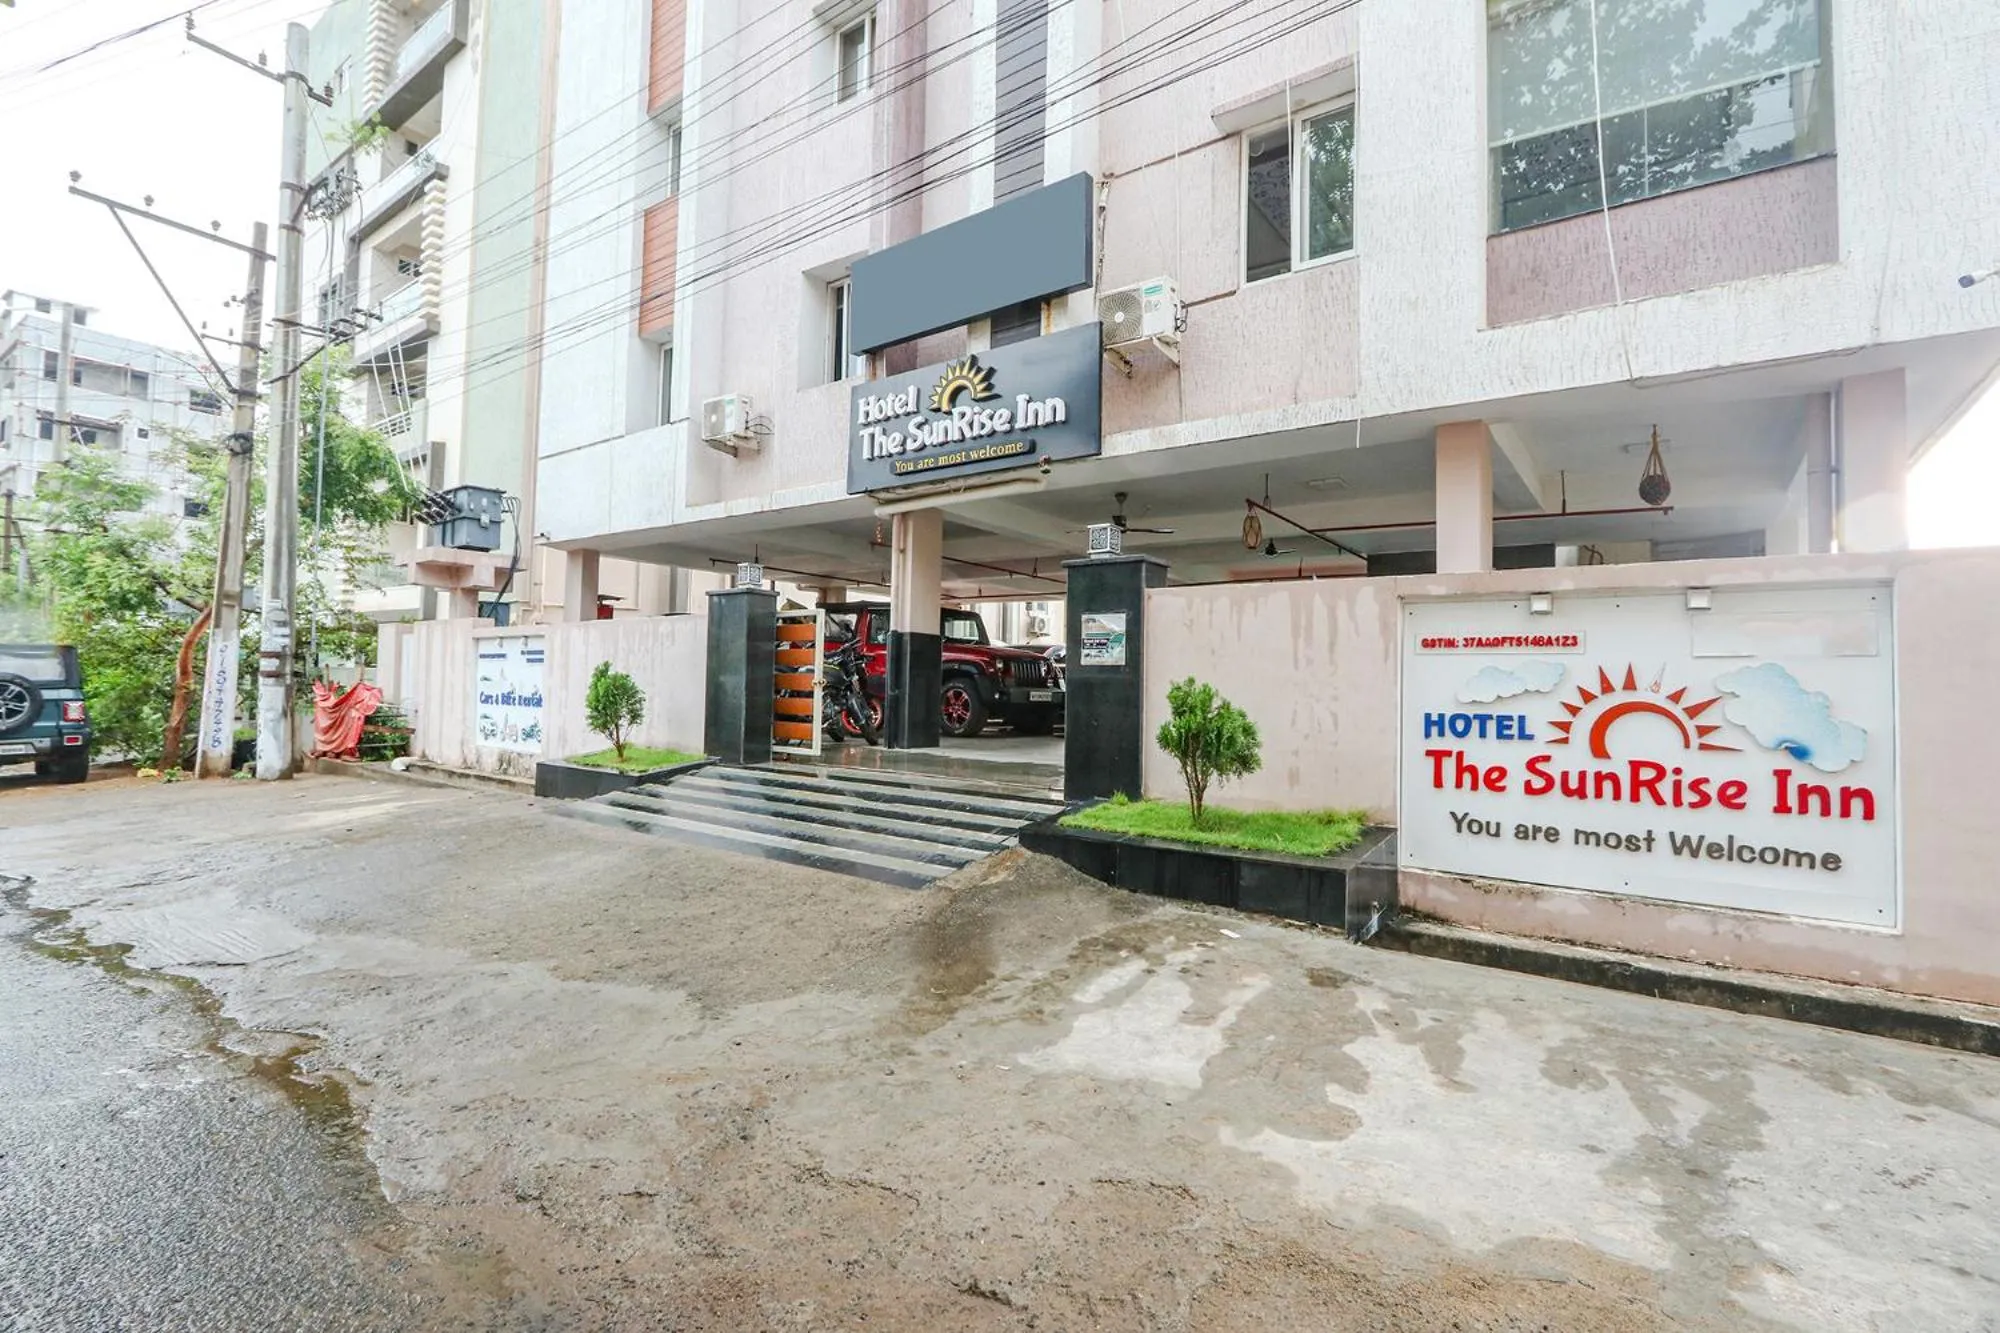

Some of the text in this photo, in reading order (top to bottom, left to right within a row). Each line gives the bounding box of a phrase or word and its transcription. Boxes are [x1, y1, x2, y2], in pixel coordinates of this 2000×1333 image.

[857, 384, 919, 424] Hotel
[859, 394, 1067, 460] The SunRise Inn
[895, 441, 1024, 473] You are most welcome
[1421, 637, 1459, 649] GSTIN:
[1424, 713, 1535, 741] HOTEL
[1425, 749, 1876, 820] The SunRise Inn
[1449, 811, 1843, 872] You are most Welcome
